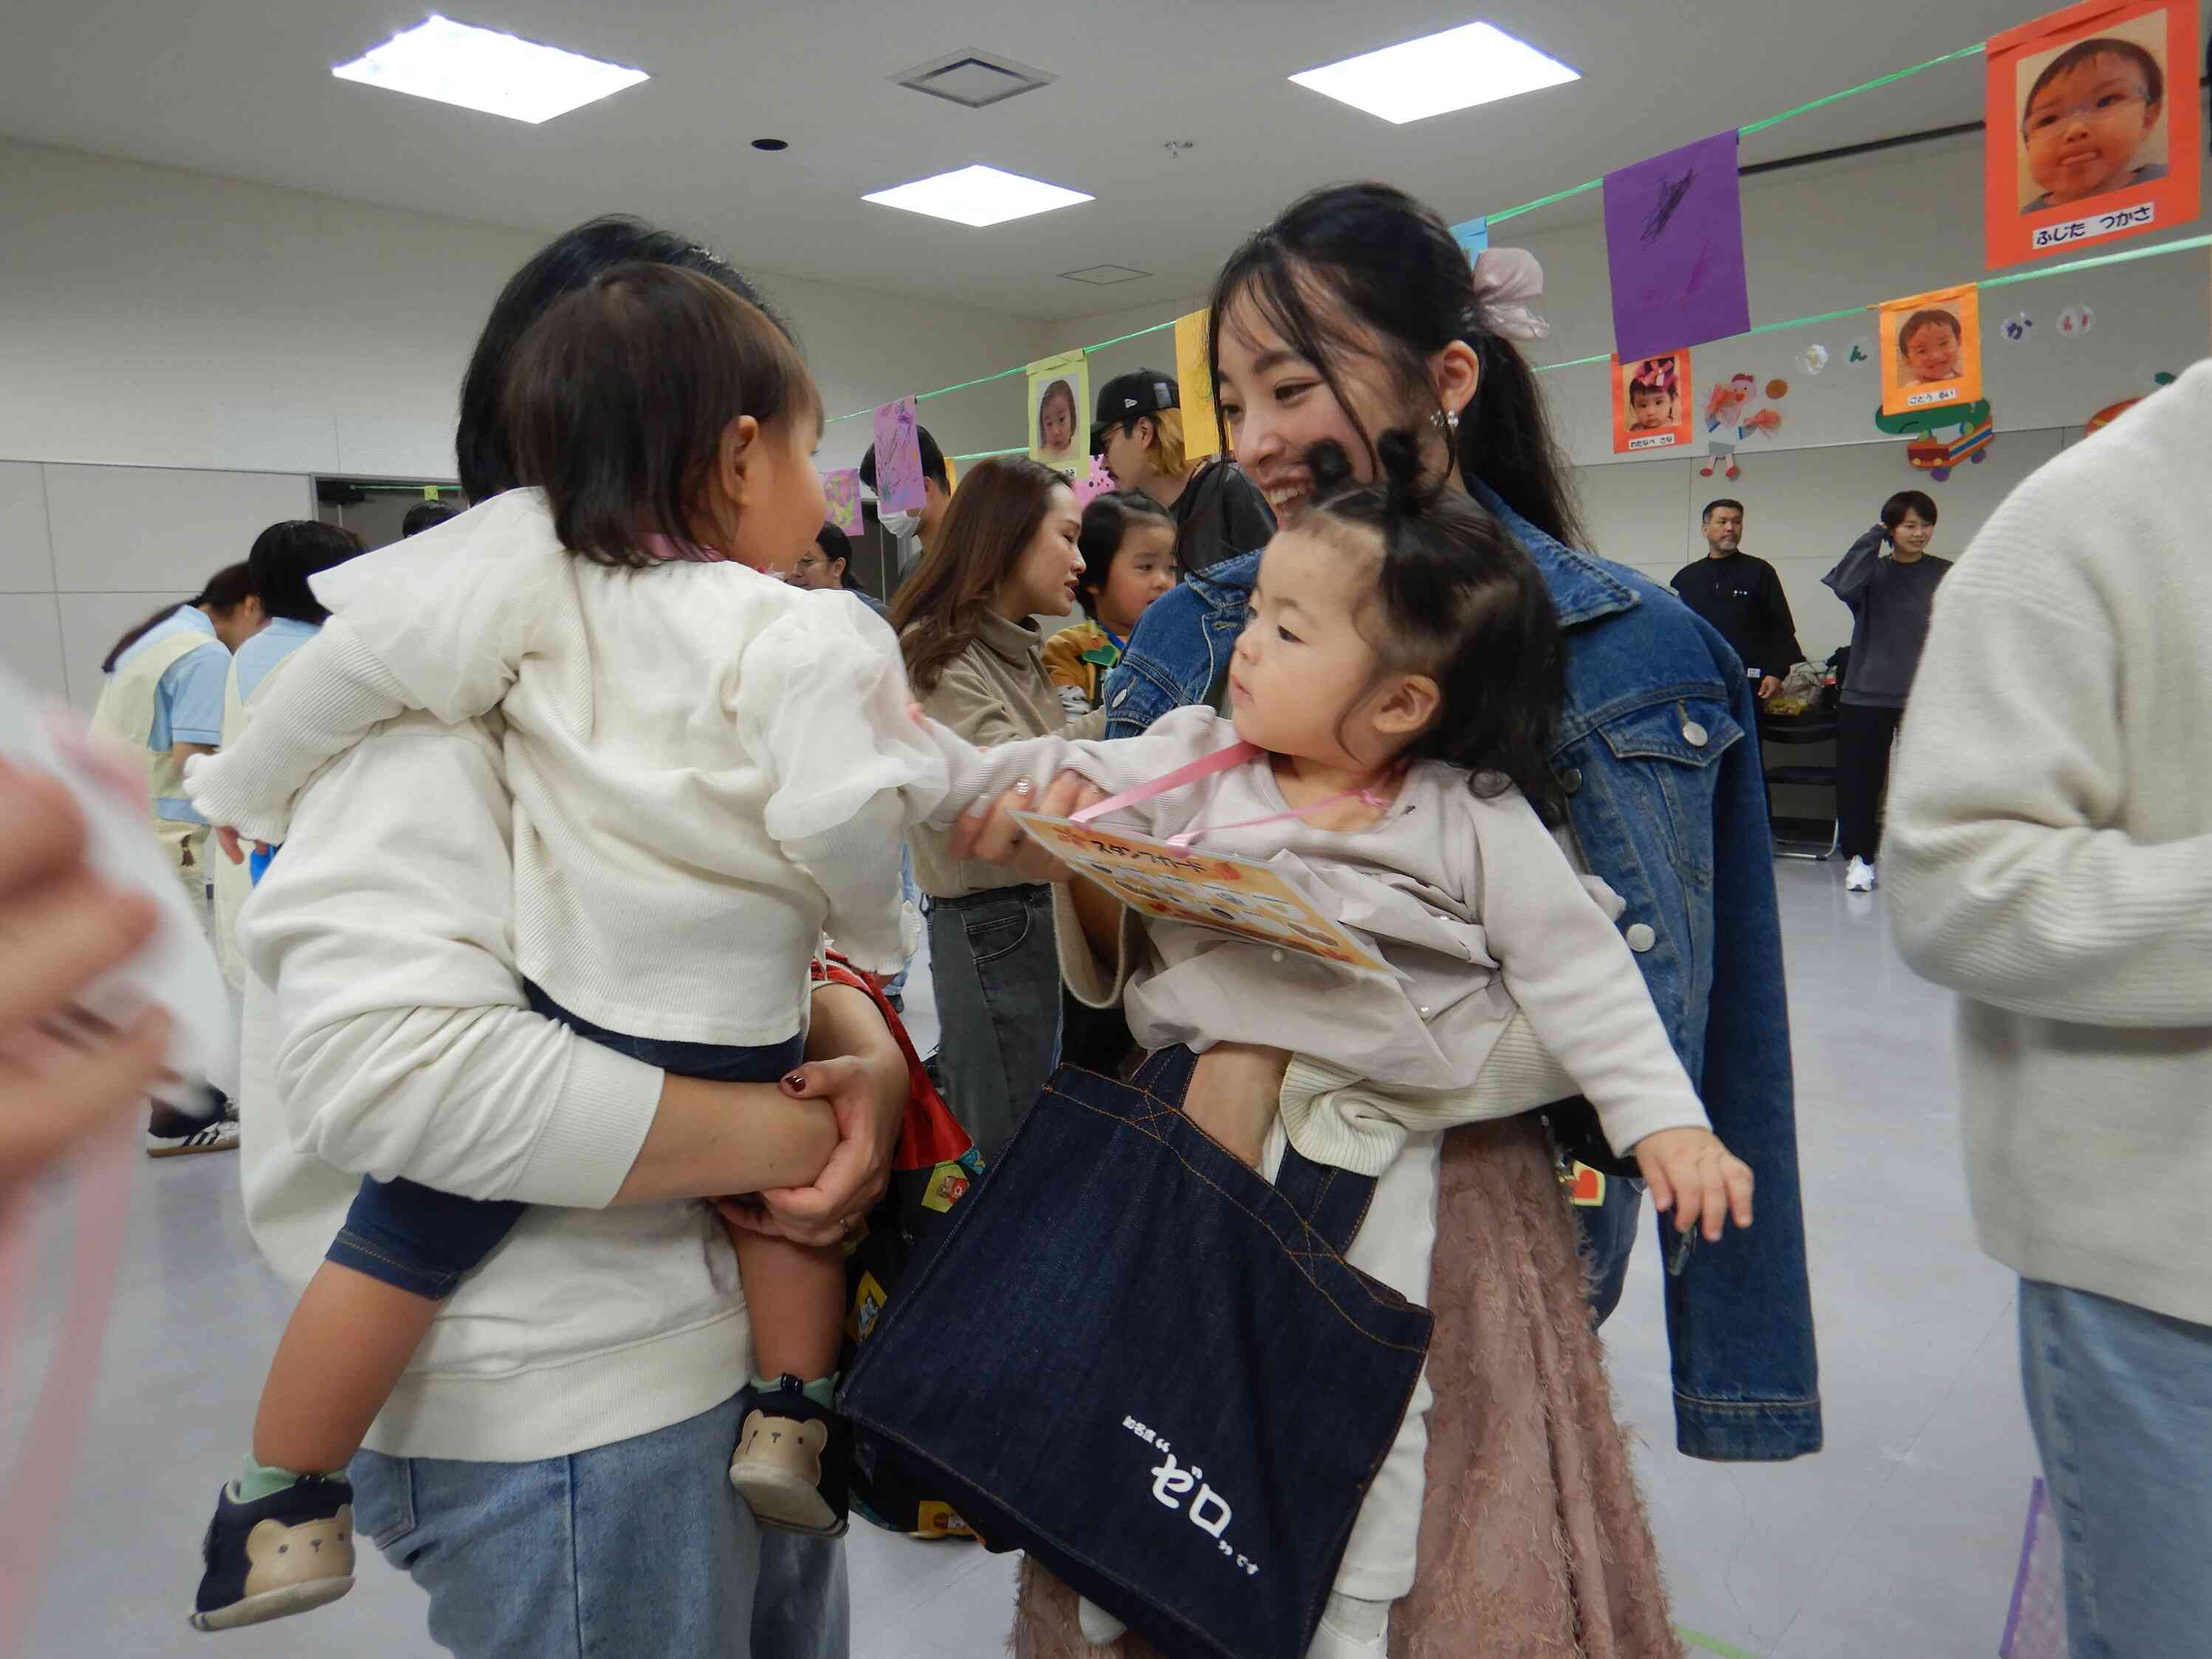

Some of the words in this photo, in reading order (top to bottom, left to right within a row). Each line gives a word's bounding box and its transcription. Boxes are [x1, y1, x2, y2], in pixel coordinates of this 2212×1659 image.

[2037, 222, 2085, 245] ふじた
[2099, 205, 2151, 230] つかさ
[1090, 839, 1206, 873] スタンプカード
